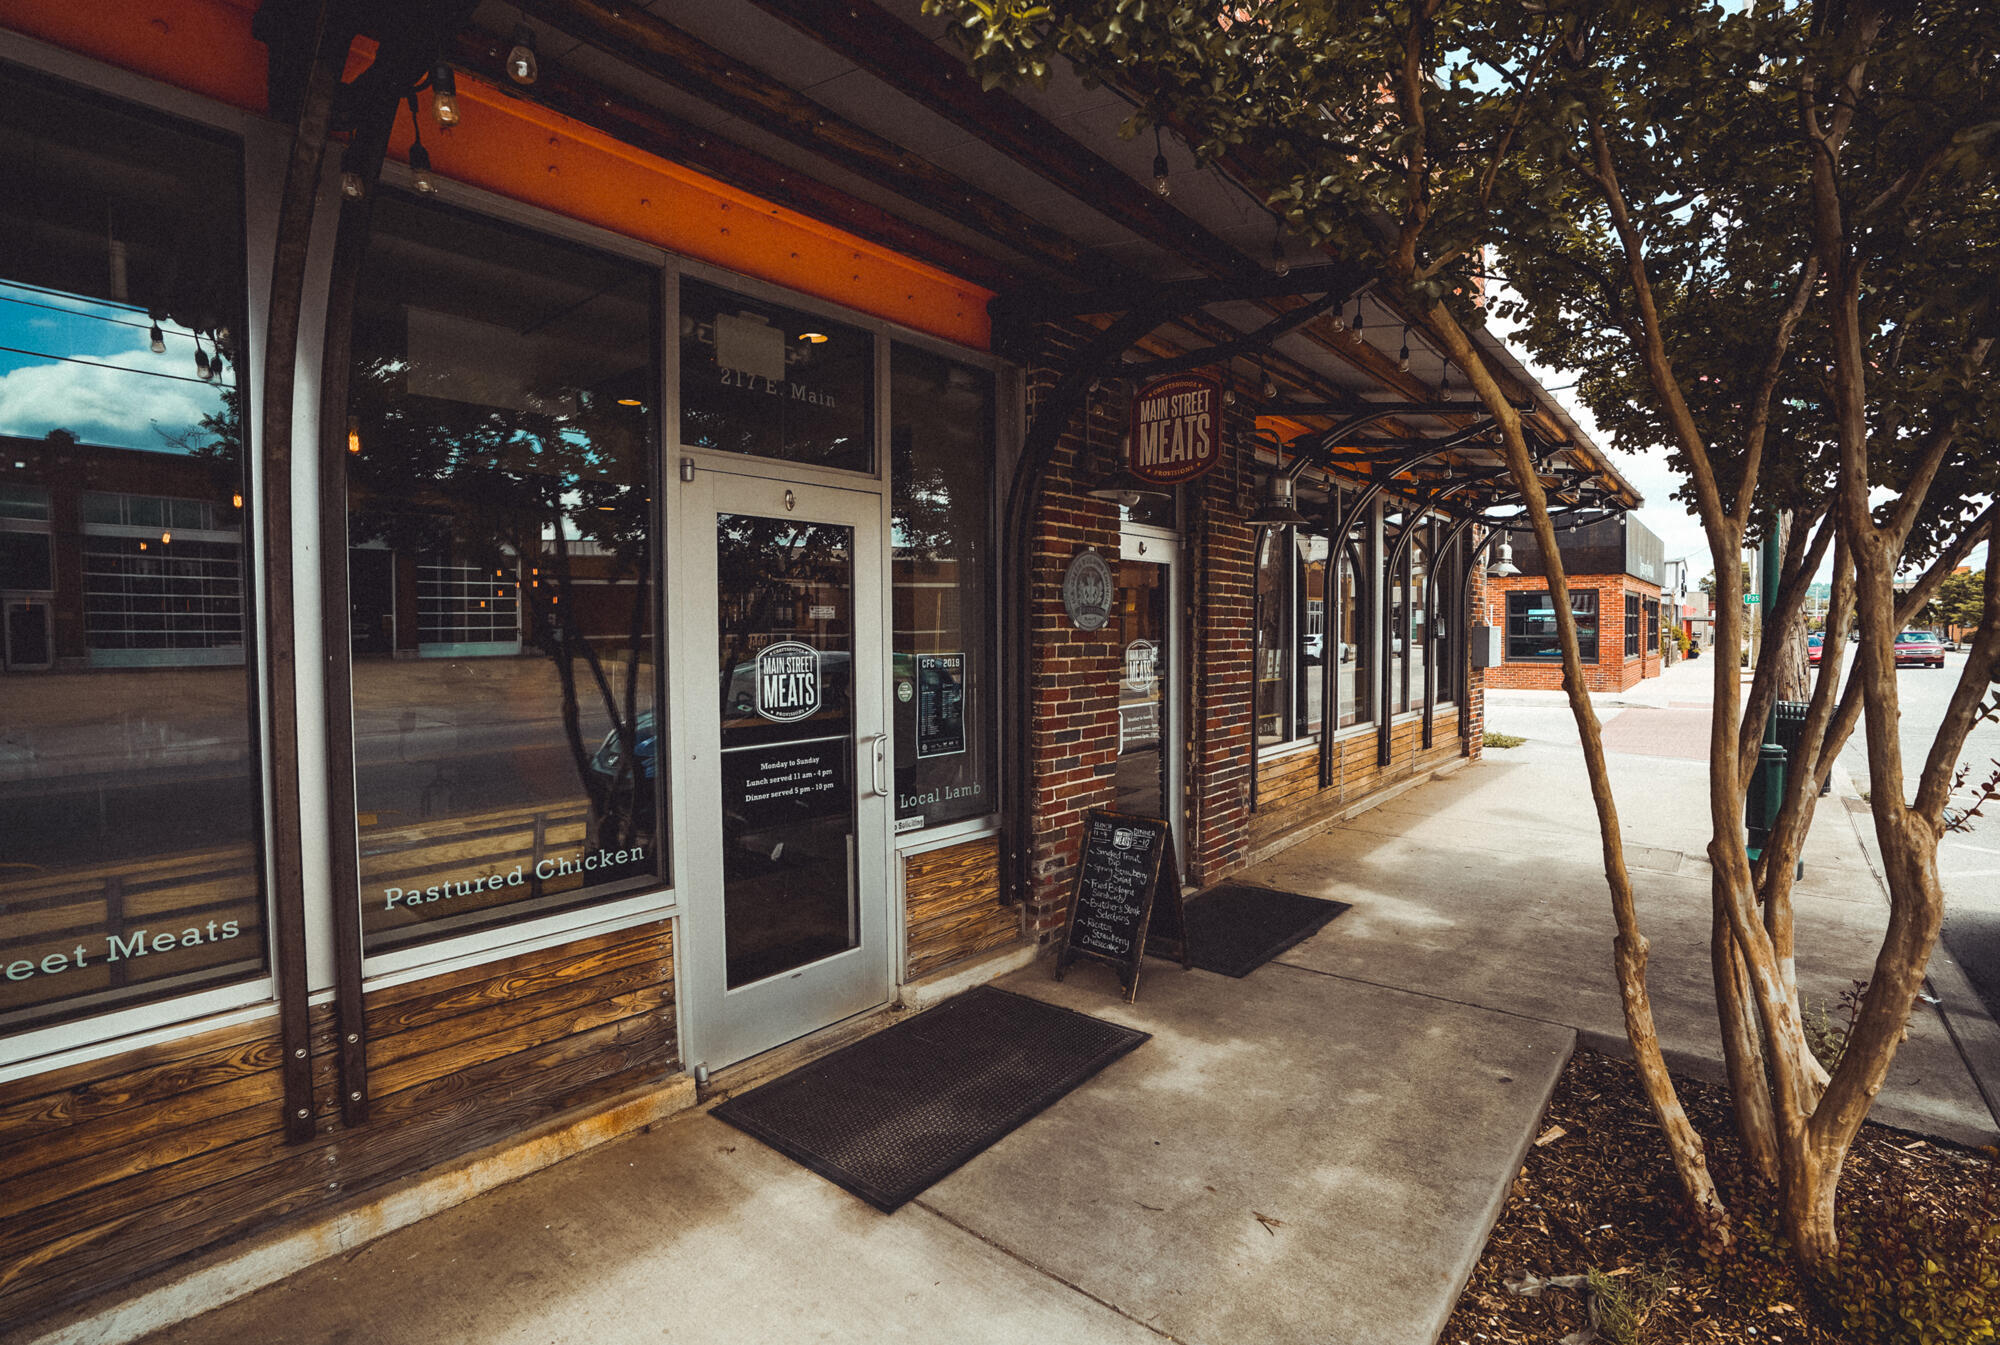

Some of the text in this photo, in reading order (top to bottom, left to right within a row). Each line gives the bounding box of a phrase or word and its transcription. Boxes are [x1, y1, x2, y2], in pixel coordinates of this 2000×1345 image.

[720, 368, 756, 390] 217
[791, 383, 836, 408] Main
[1140, 389, 1211, 422] MAIN STREET
[1140, 412, 1210, 466] MEATS
[1747, 594, 1759, 602] Pas
[764, 656, 814, 674] MAIN STREET
[922, 658, 960, 668] CFC 2019
[1129, 660, 1152, 682] MEATS
[764, 673, 815, 708] MEATS
[760, 761, 788, 771] Monday
[796, 757, 820, 765] Sunday
[746, 778, 768, 787] Lunch
[770, 774, 792, 784] served
[822, 769, 832, 777] pm
[745, 793, 769, 802] Dinner
[771, 788, 793, 798] served
[824, 783, 834, 791] pm
[900, 781, 981, 808] Local Lamb
[384, 847, 645, 911] Pastured Chicken
[0, 919, 240, 981] eet Meats
